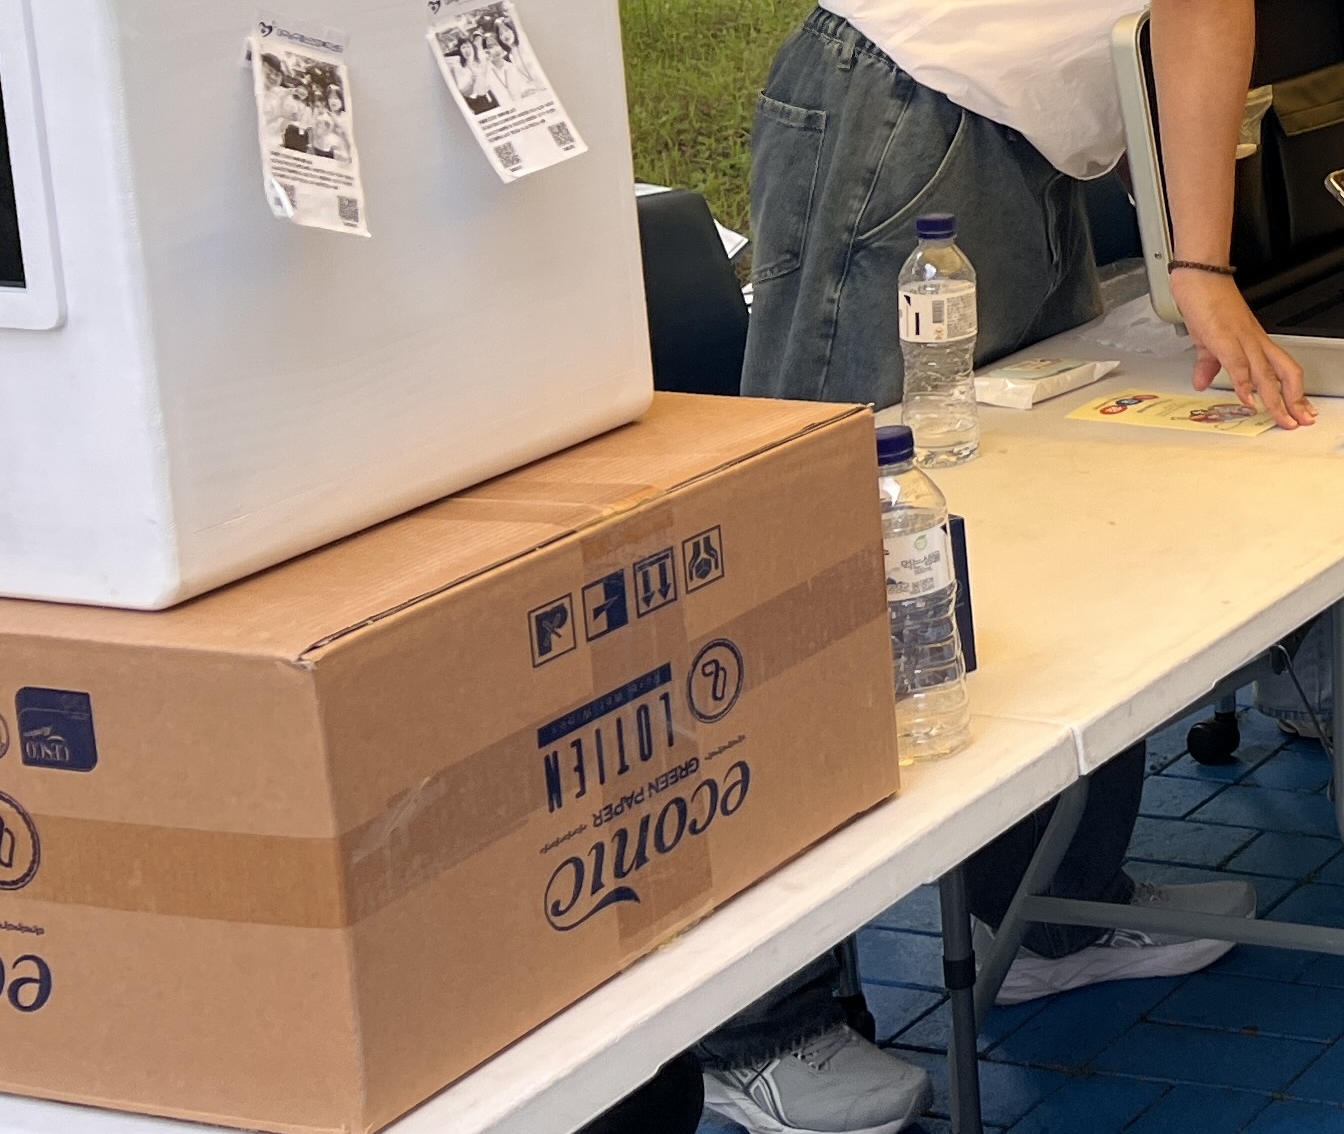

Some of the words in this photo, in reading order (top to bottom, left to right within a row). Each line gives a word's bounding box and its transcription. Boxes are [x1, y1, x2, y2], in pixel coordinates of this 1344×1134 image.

[544, 691, 674, 813] LOTIEN
[649, 757, 700, 795] GREEN
[544, 760, 750, 931] econic
[592, 788, 645, 828] PAPER
